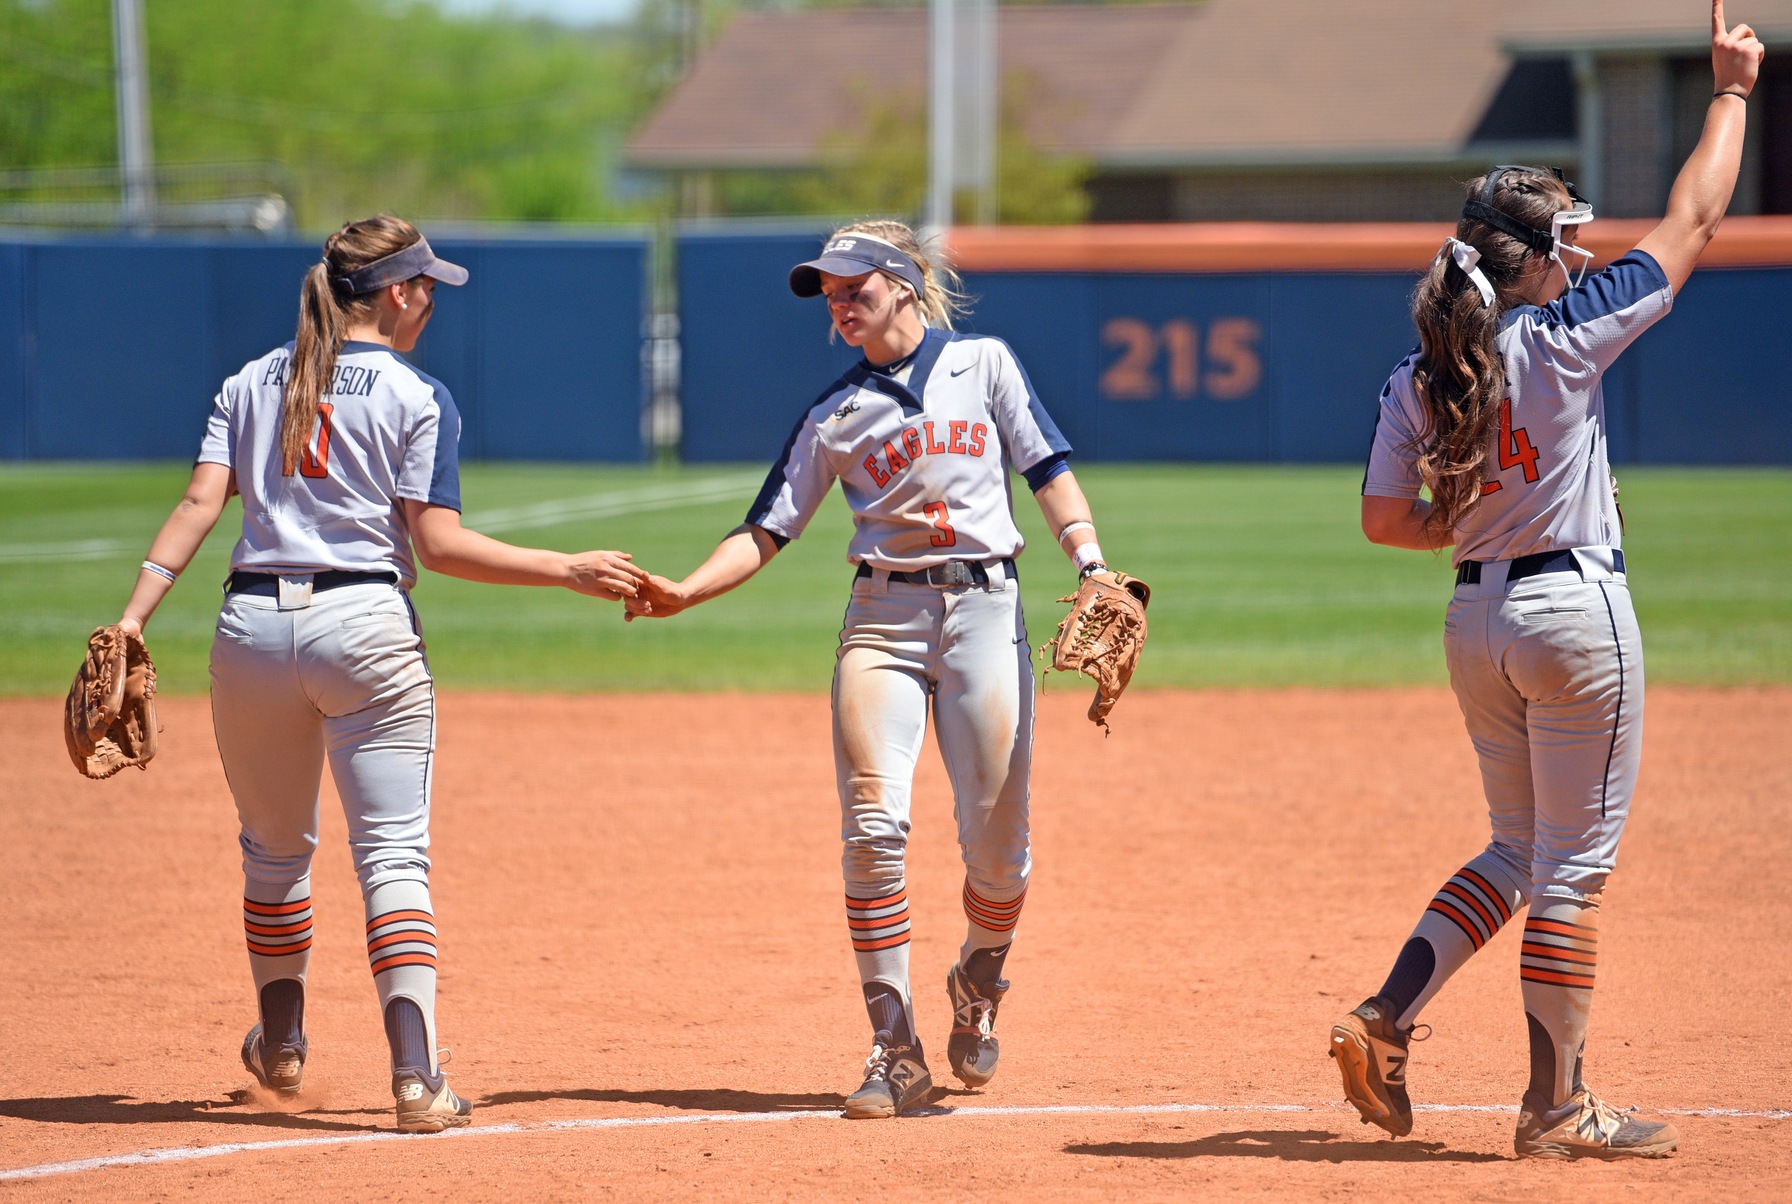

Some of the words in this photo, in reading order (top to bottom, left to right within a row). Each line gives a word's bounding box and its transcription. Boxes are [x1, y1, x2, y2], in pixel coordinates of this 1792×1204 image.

[262, 356, 381, 397] PARSON
[1100, 317, 1262, 400] 215
[834, 401, 861, 421] SAC
[863, 420, 988, 490] EAGLES
[923, 500, 956, 547] 3
